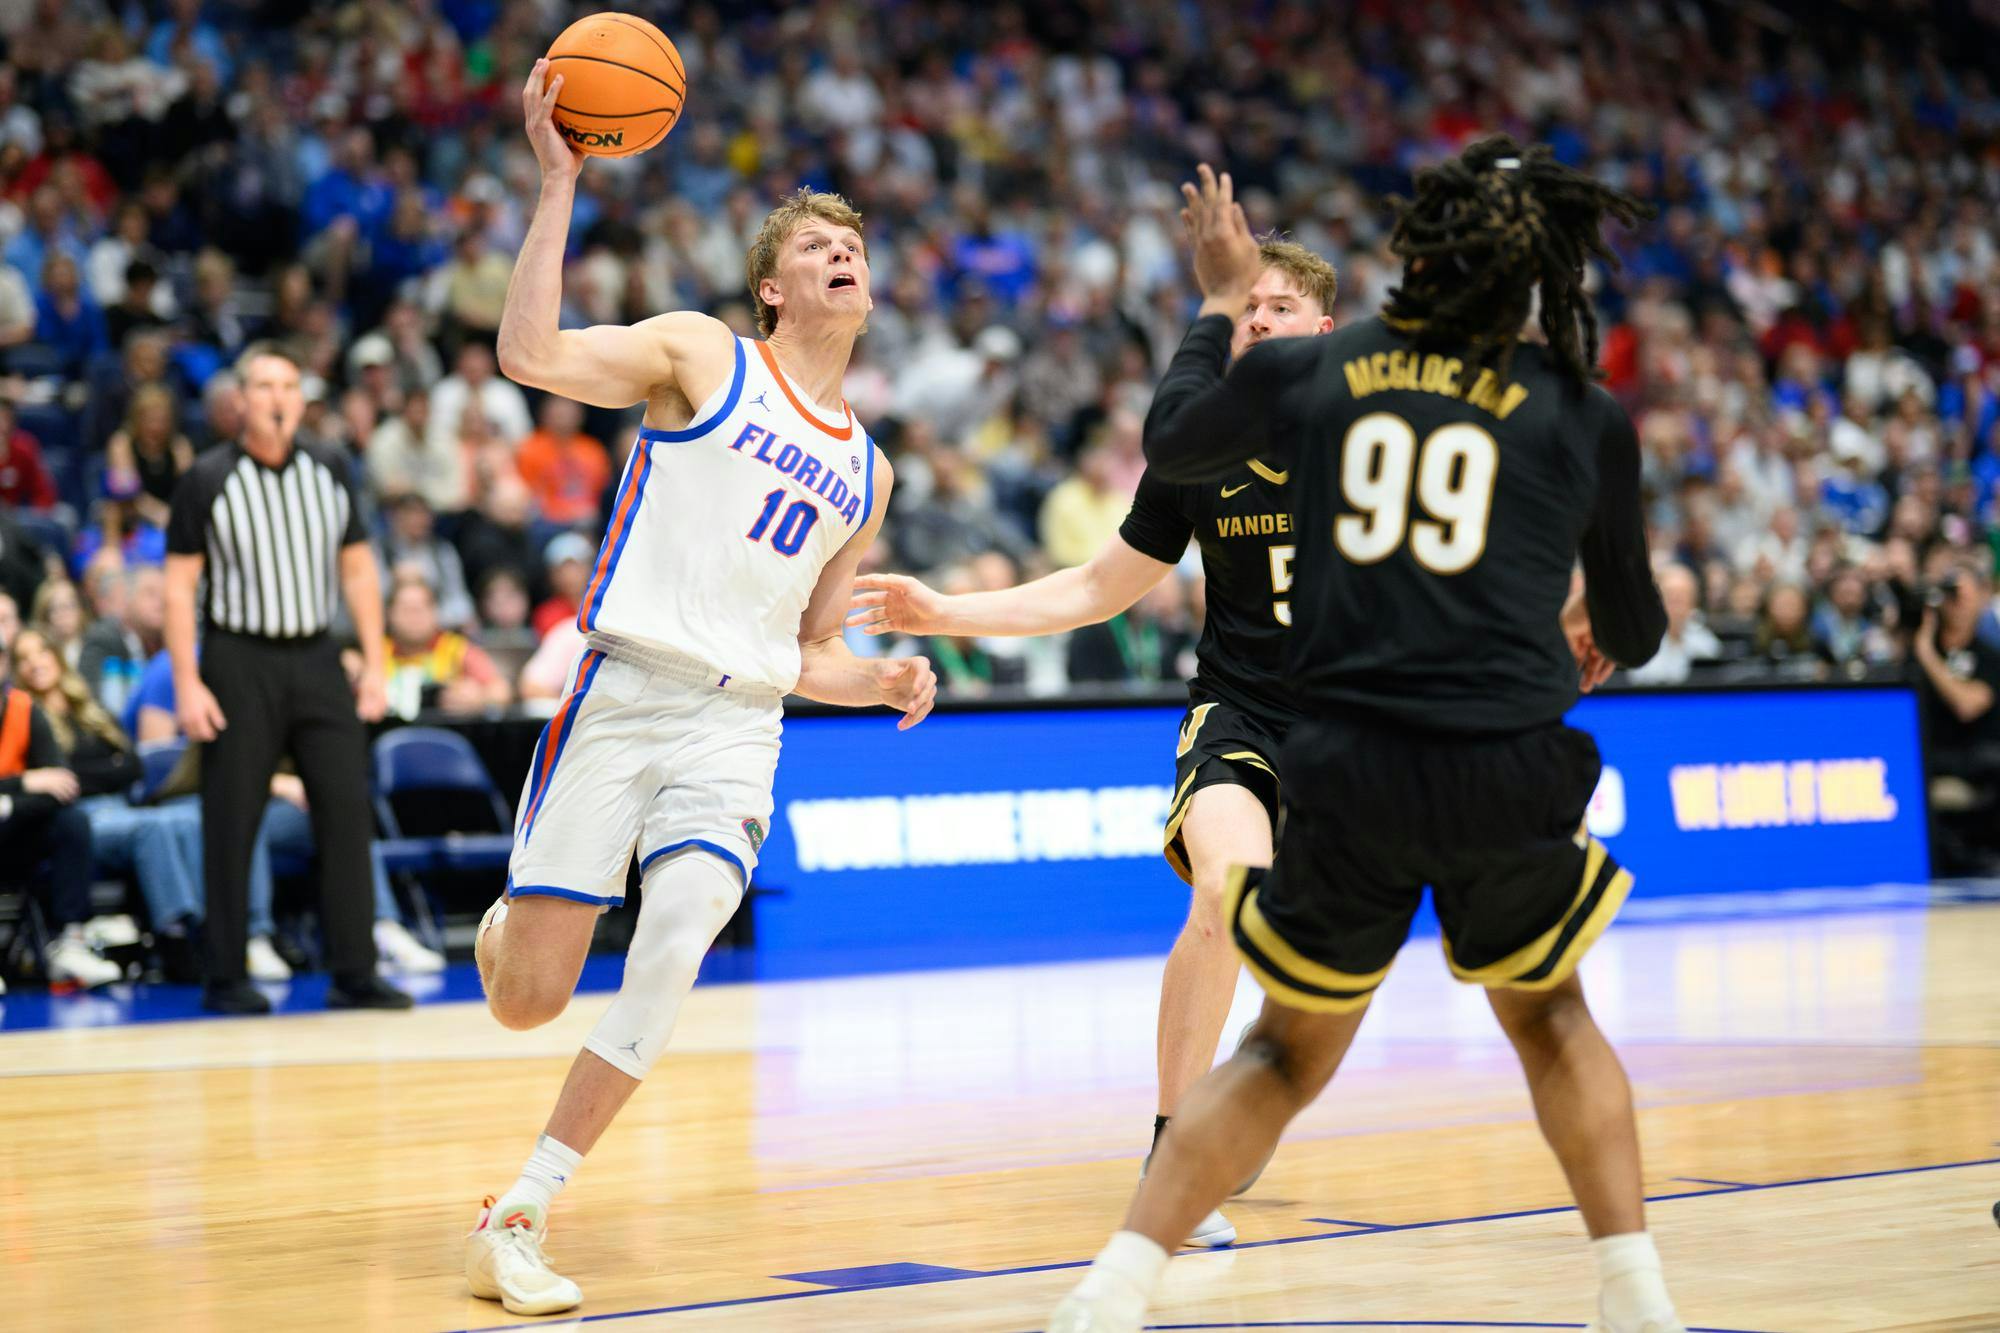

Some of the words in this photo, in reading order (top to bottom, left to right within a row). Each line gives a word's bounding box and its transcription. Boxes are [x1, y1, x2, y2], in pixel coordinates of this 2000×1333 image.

[727, 421, 862, 527] FLORIDA
[1333, 410, 1500, 577] 99
[745, 487, 820, 559] 10
[1216, 512, 1295, 538] VANDE
